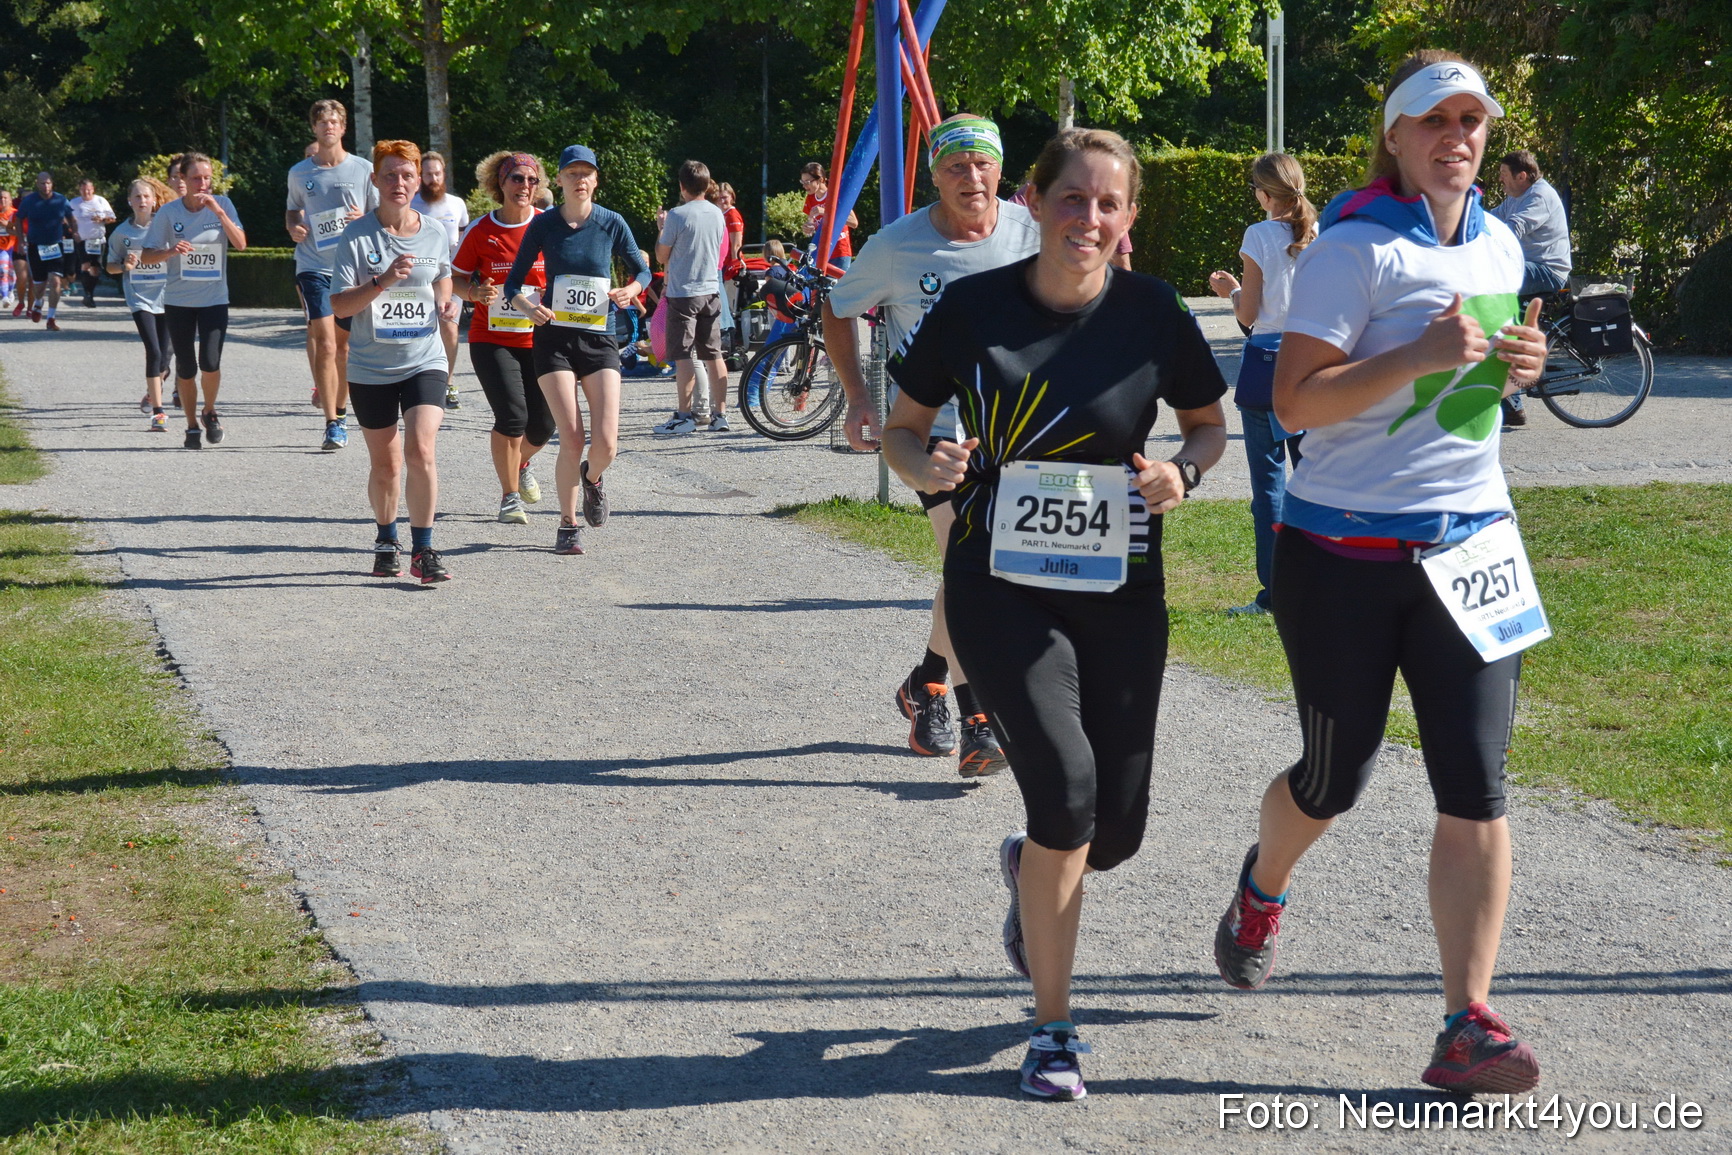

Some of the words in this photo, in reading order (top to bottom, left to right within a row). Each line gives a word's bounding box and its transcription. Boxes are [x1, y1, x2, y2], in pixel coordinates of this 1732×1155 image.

[318, 218, 345, 235] 3033
[187, 253, 216, 266] 3079
[566, 289, 597, 307] 306
[381, 302, 426, 320] 2484
[568, 313, 592, 323] Sophie
[392, 329, 419, 337] Andrea
[1039, 473, 1094, 488] BOCK
[1014, 495, 1111, 537] 2554
[1021, 539, 1050, 548] PARTL
[1051, 541, 1090, 551] Neumarkt
[1039, 558, 1079, 575] Julia
[1452, 557, 1520, 612] 2257
[1498, 621, 1523, 642] Julia
